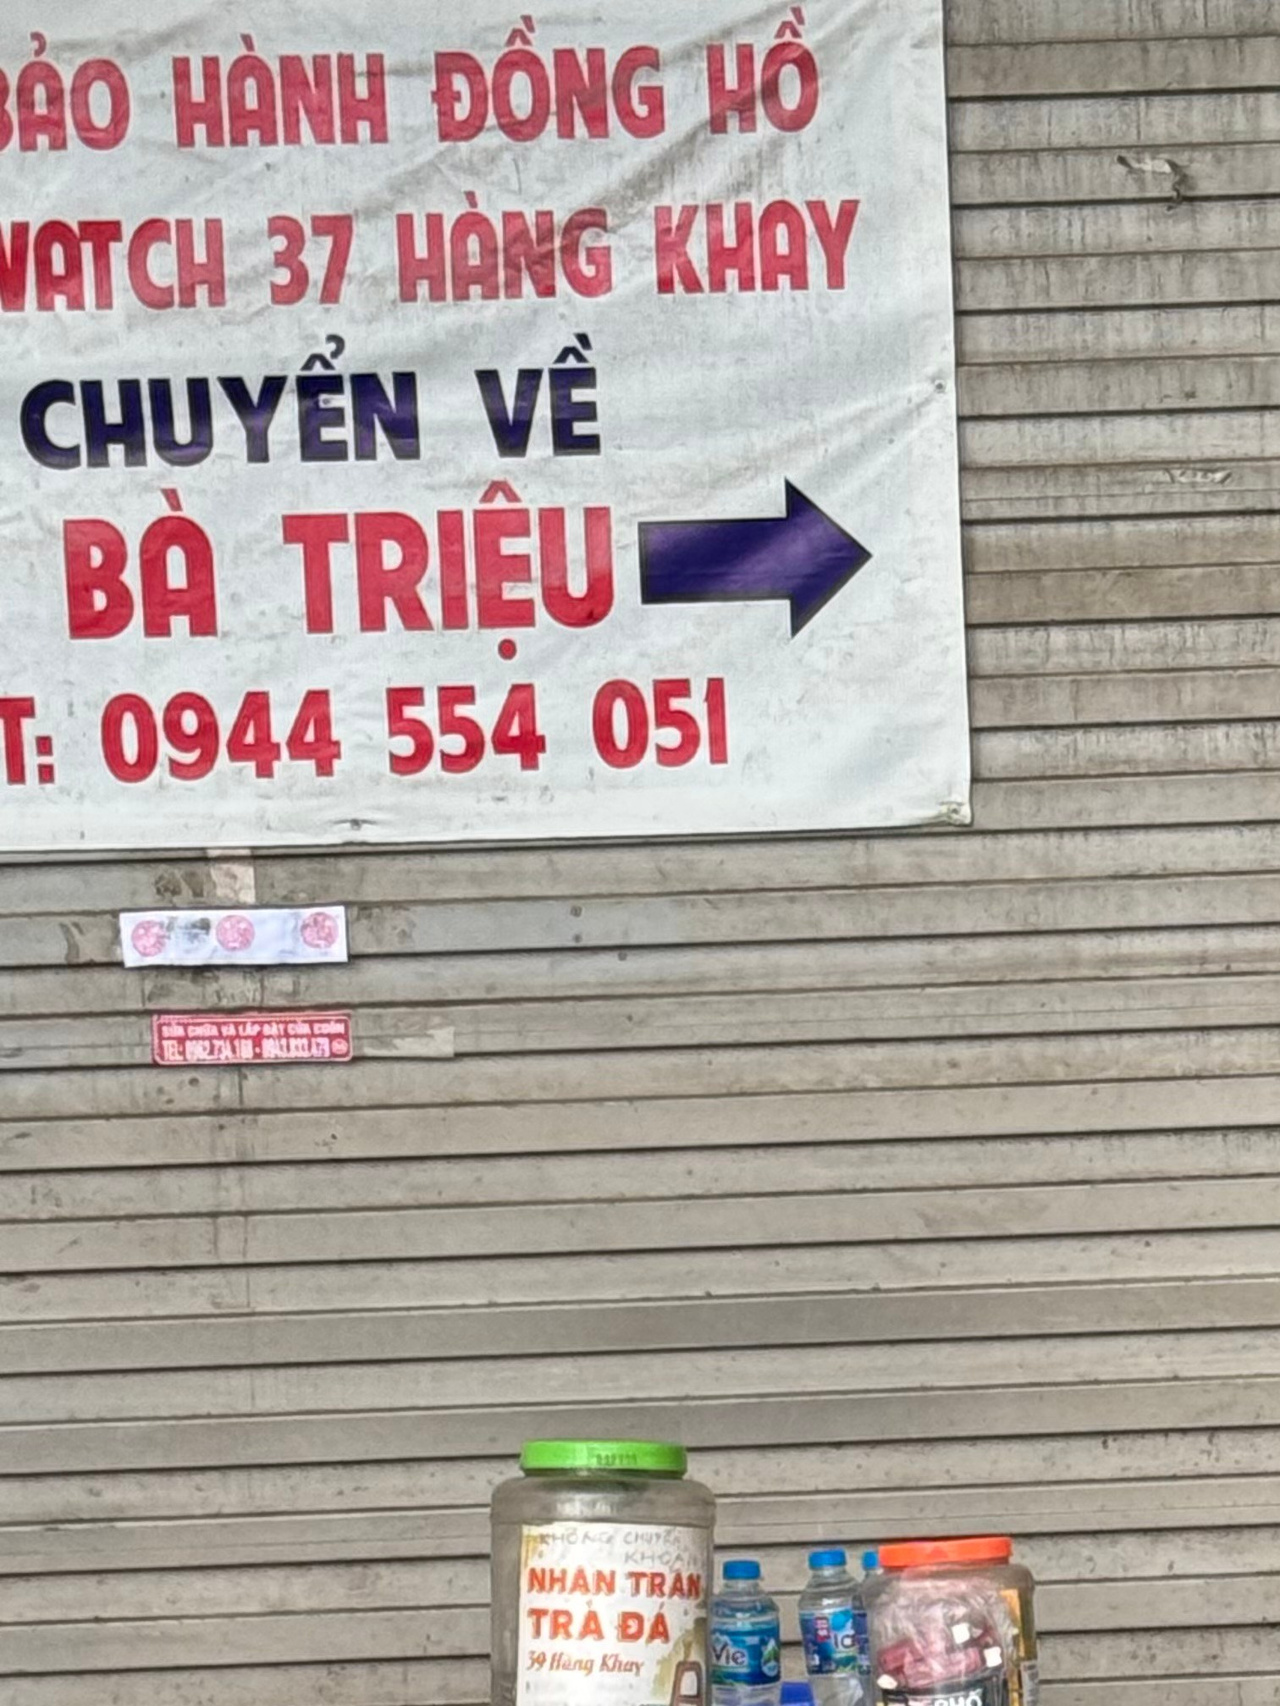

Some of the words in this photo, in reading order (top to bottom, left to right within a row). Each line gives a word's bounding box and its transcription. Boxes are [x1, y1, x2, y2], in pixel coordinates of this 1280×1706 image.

[172, 34, 389, 148] HÀNH
[431, 14, 667, 144] ĐỒNG
[707, 9, 820, 136] HỒ
[267, 214, 355, 306] 37
[399, 191, 613, 304] HÀNG
[654, 199, 862, 296] KHAY
[20, 334, 421, 471] CHUYỂN
[474, 333, 602, 458] VỀ
[62, 489, 218, 640] BÀ
[281, 480, 617, 661] TRIỆU
[101, 689, 342, 784] 0944
[386, 682, 546, 777] 554
[590, 677, 729, 769] 051
